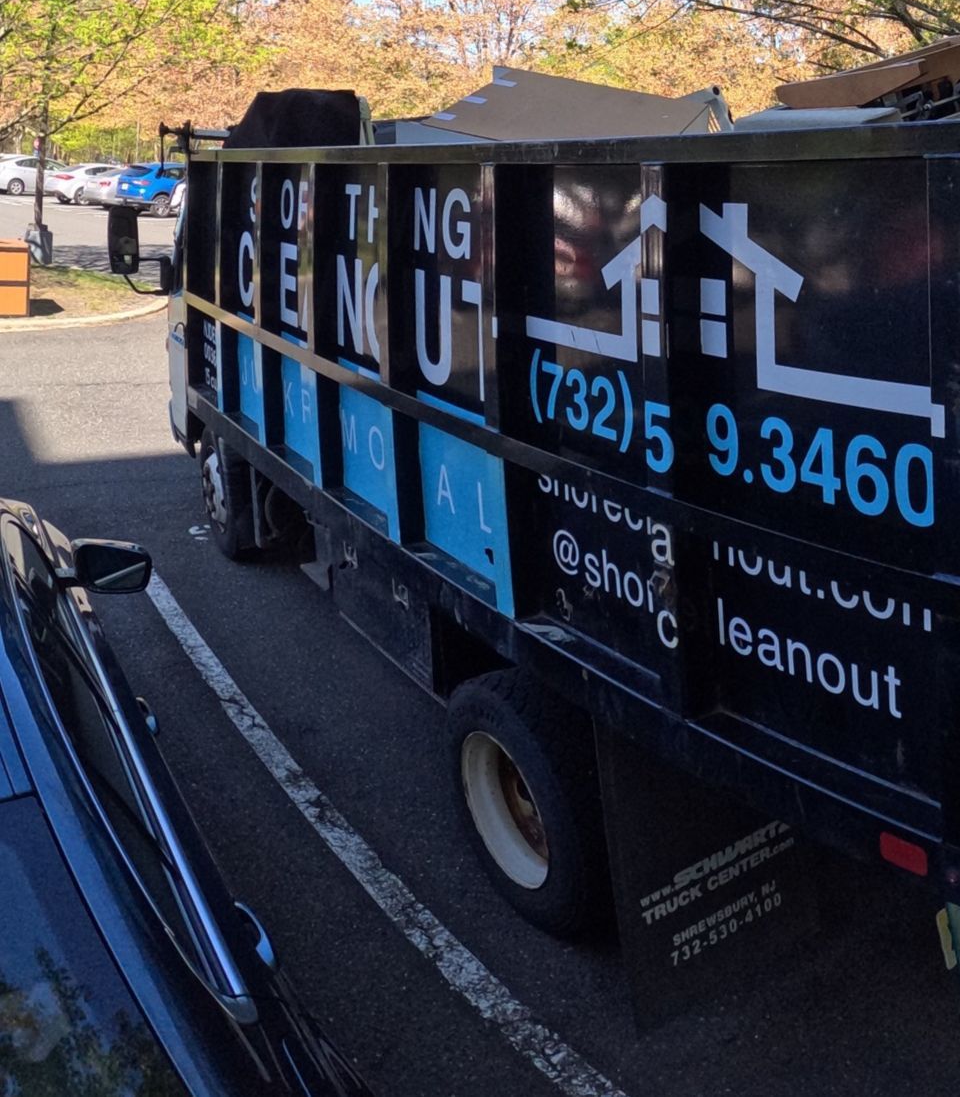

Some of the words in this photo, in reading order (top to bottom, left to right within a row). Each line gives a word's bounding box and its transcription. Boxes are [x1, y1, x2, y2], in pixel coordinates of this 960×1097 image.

[642, 882, 703, 925] TRUCK
[761, 880, 777, 896] NJ
[670, 893, 782, 966] 732-530-4100
